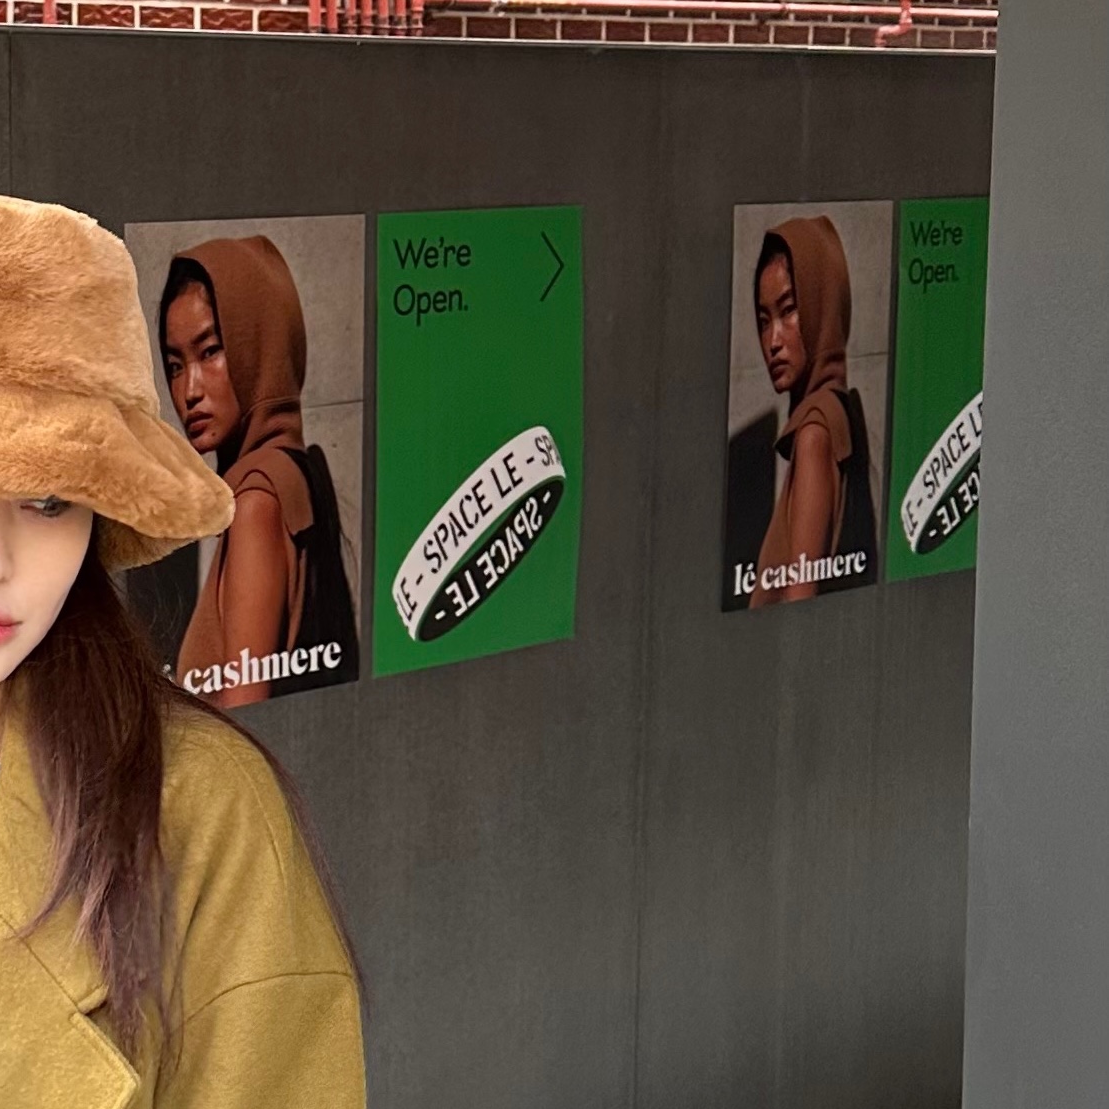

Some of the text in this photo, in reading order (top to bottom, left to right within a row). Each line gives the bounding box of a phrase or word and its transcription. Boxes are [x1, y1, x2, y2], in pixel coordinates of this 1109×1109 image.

[393, 236, 472, 269] We're
[909, 219, 963, 248] We're
[908, 258, 959, 294] Open.
[393, 284, 469, 327] Open.
[922, 421, 971, 499] SPACE
[422, 479, 493, 574] SPACE
[490, 451, 523, 498] LE
[734, 551, 867, 596] lé cashmere
[182, 641, 341, 695] cashmere
